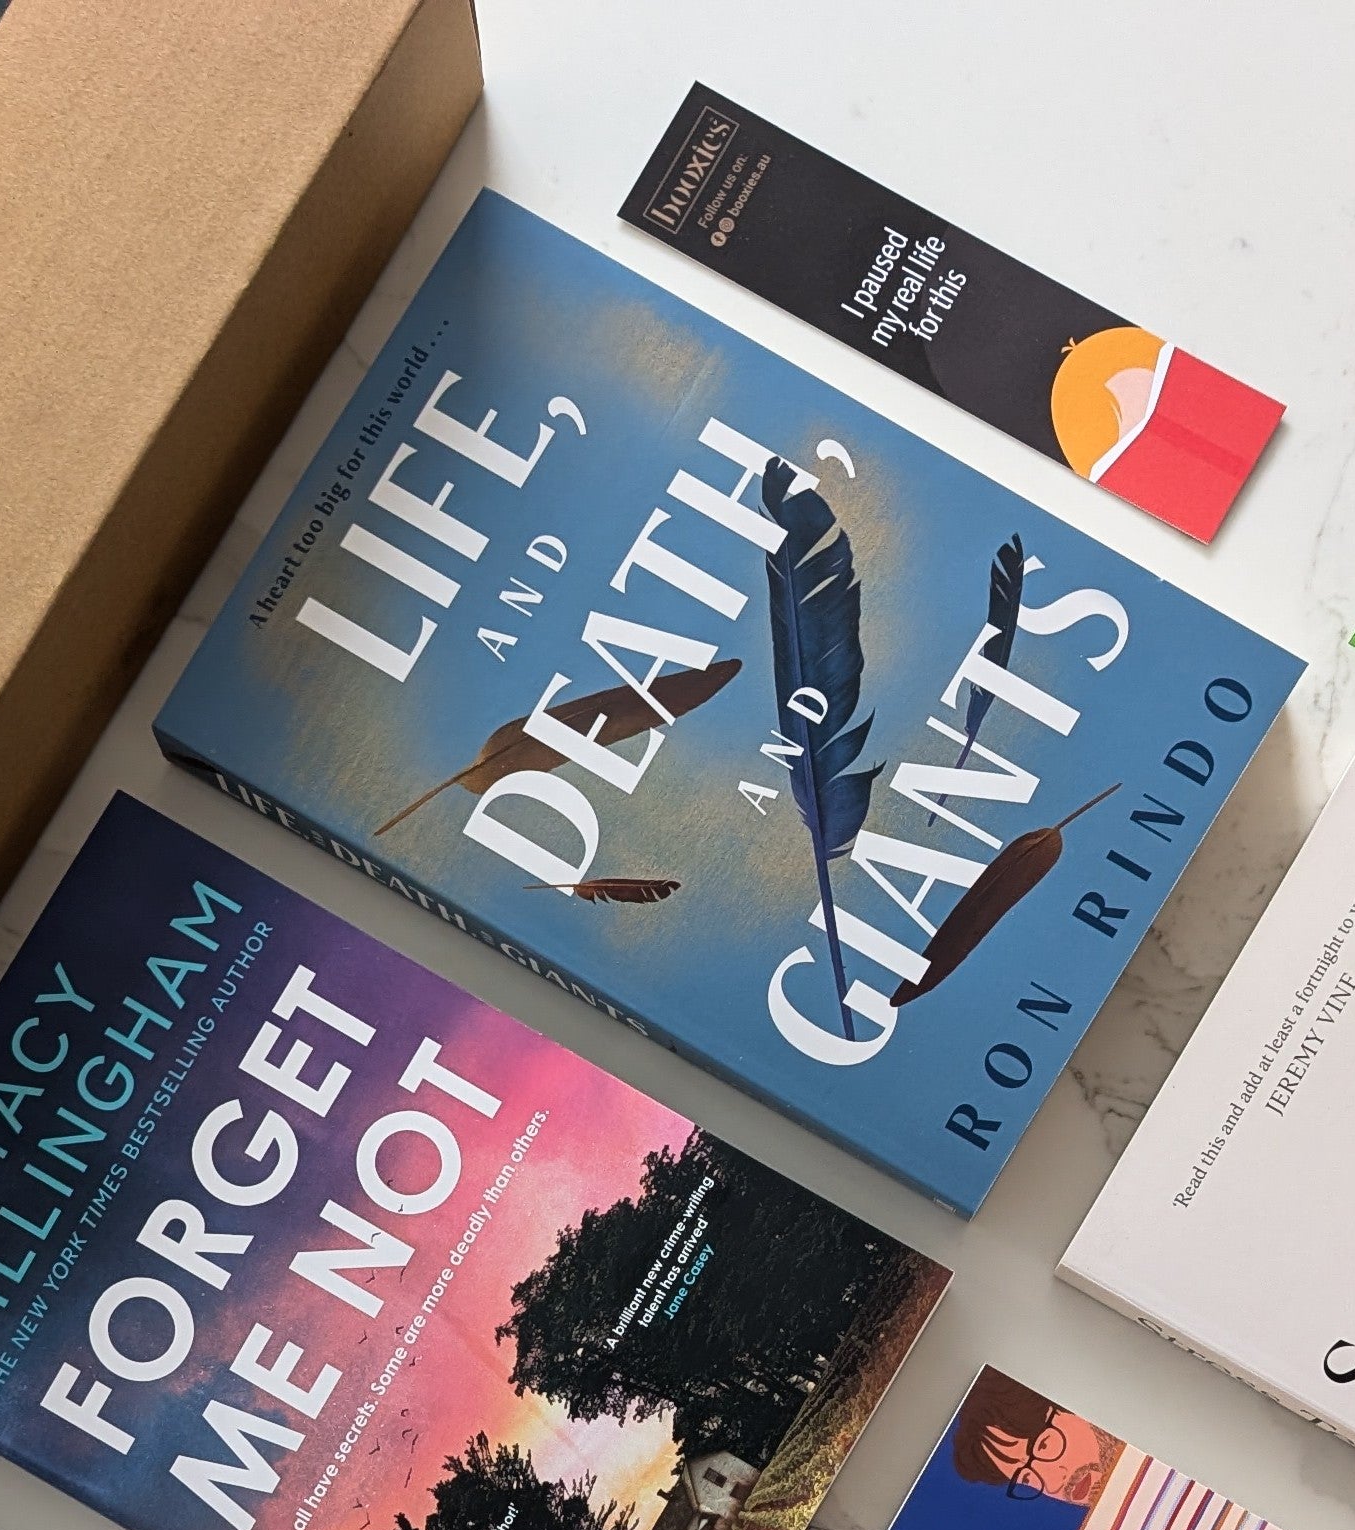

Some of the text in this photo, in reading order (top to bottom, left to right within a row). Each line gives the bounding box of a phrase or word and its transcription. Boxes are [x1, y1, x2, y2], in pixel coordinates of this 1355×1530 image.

[650, 119, 731, 226] booxies
[840, 226, 909, 319] I paused
[871, 236, 946, 347] my real life
[908, 269, 967, 342] for this
[248, 344, 429, 630] A heart too big for this world
[295, 369, 587, 683] LIFE,
[476, 534, 568, 663] AND
[462, 416, 857, 886] DEATH,
[737, 686, 829, 816] AND
[767, 555, 1129, 1066] GIANTS
[944, 677, 1253, 1152] RON RINDO
[10, 1294, 48, 1350] NEW
[42, 1230, 88, 1291] YORK
[79, 1163, 128, 1229] TIMES
[121, 1016, 215, 1160] BESTSELLING
[211, 921, 274, 1013] AUTHOR
[39, 964, 377, 1455] FORGET
[288, 1036, 502, 1319] NOT
[1264, 1027, 1325, 1118] JEREMY
[303, 1464, 339, 1509] have
[334, 1400, 379, 1463] secrets.
[370, 1347, 408, 1396] Some
[403, 1315, 427, 1345] are
[421, 1268, 454, 1314] more
[449, 1204, 493, 1266] deadly
[482, 1164, 519, 1204] than
[510, 1110, 550, 1171] others.
